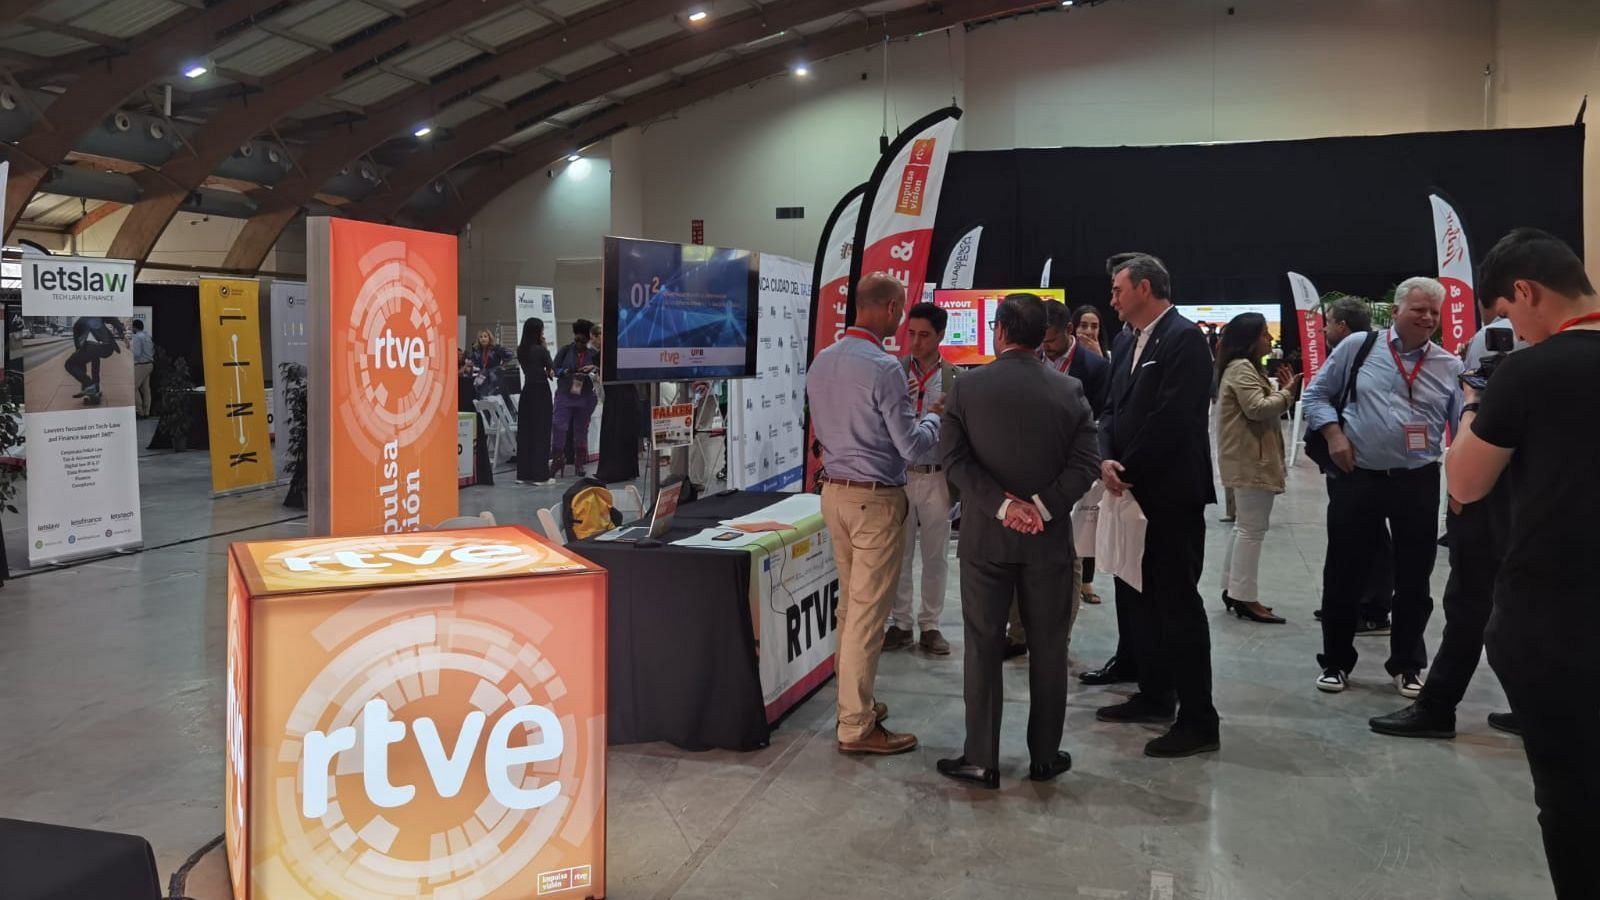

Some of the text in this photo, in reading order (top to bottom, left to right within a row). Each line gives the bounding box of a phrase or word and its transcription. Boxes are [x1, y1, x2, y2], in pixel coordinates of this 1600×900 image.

[899, 170, 914, 209] impulsa
[890, 239, 915, 262] &
[33, 263, 127, 292] letslaw
[770, 278, 790, 293] CIUDAD
[790, 281, 800, 295] DEL
[940, 301, 972, 309] LAYOUT
[374, 328, 426, 376] rtve
[659, 350, 680, 365] rtve
[402, 468, 421, 531] ión
[284, 544, 533, 571] rtve
[786, 577, 840, 665] RTVE
[302, 698, 565, 819] rtve
